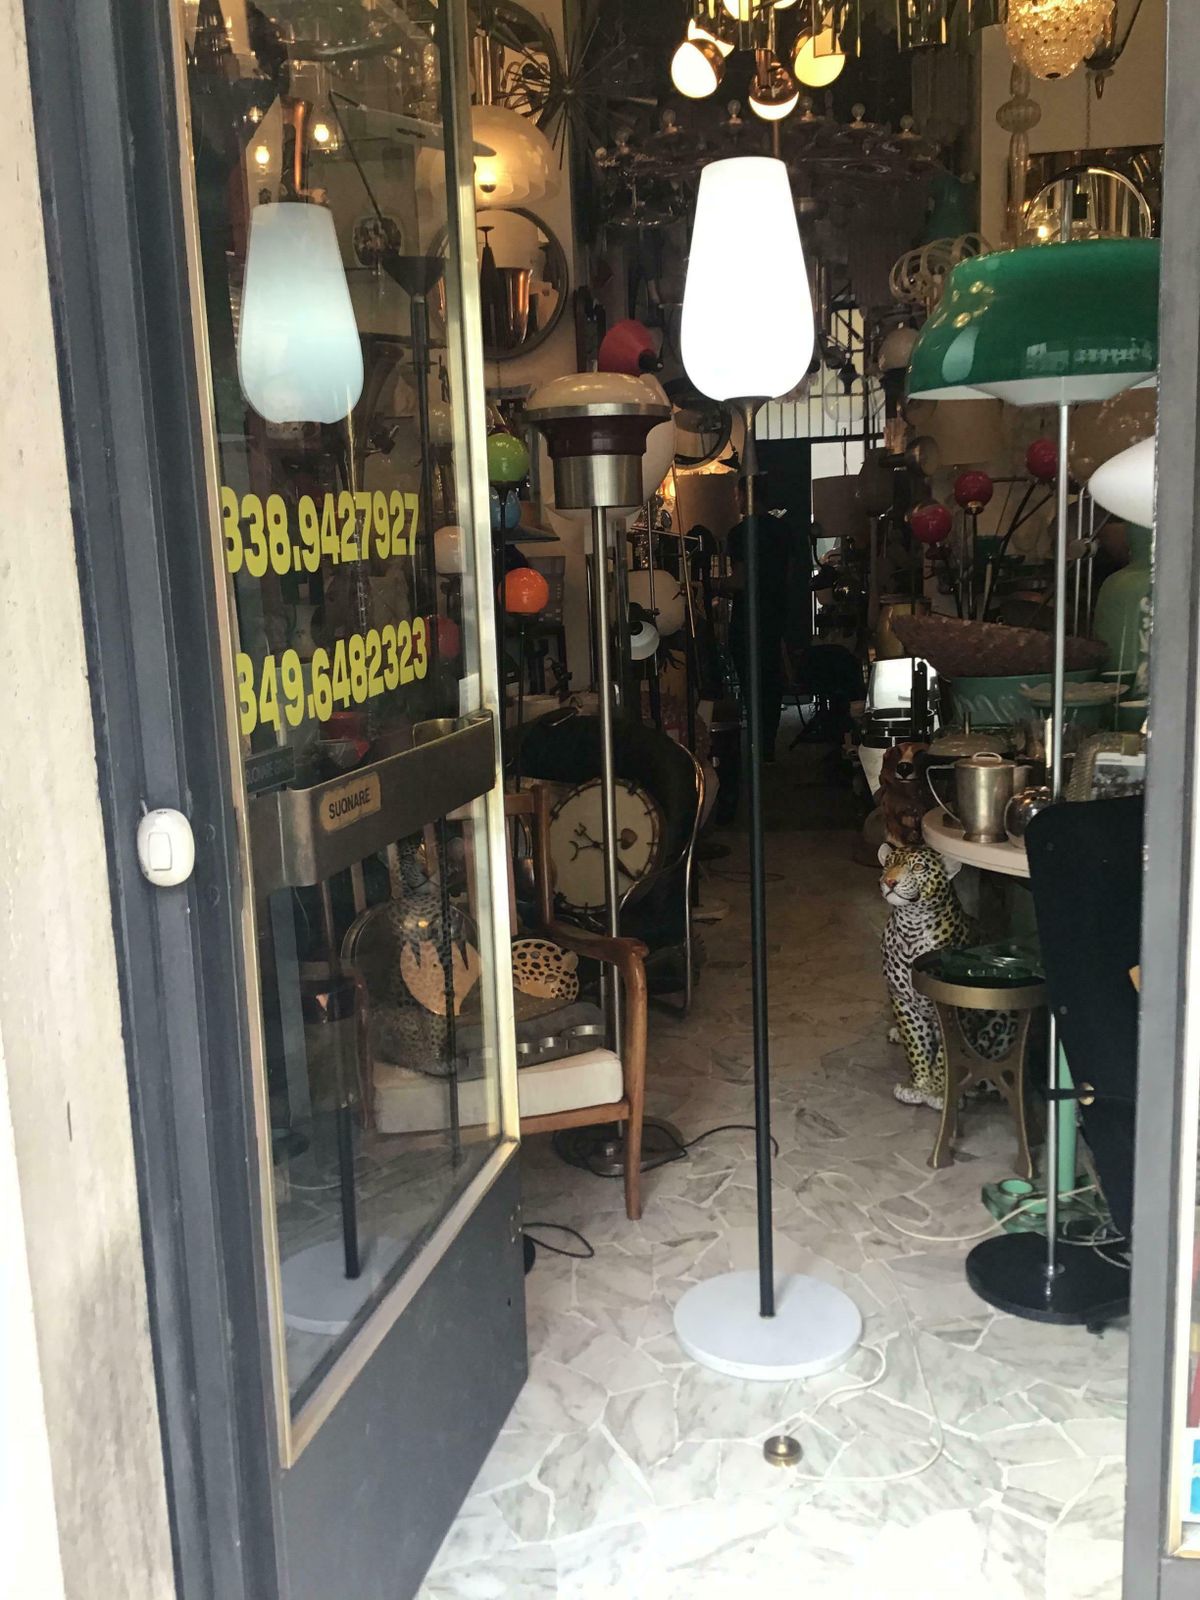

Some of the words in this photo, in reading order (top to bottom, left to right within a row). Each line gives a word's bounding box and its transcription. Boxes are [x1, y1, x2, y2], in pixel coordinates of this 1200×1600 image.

[219, 486, 419, 577] 338.9427927
[235, 617, 427, 737] 349.6482323
[328, 787, 371, 820] SUONARE
